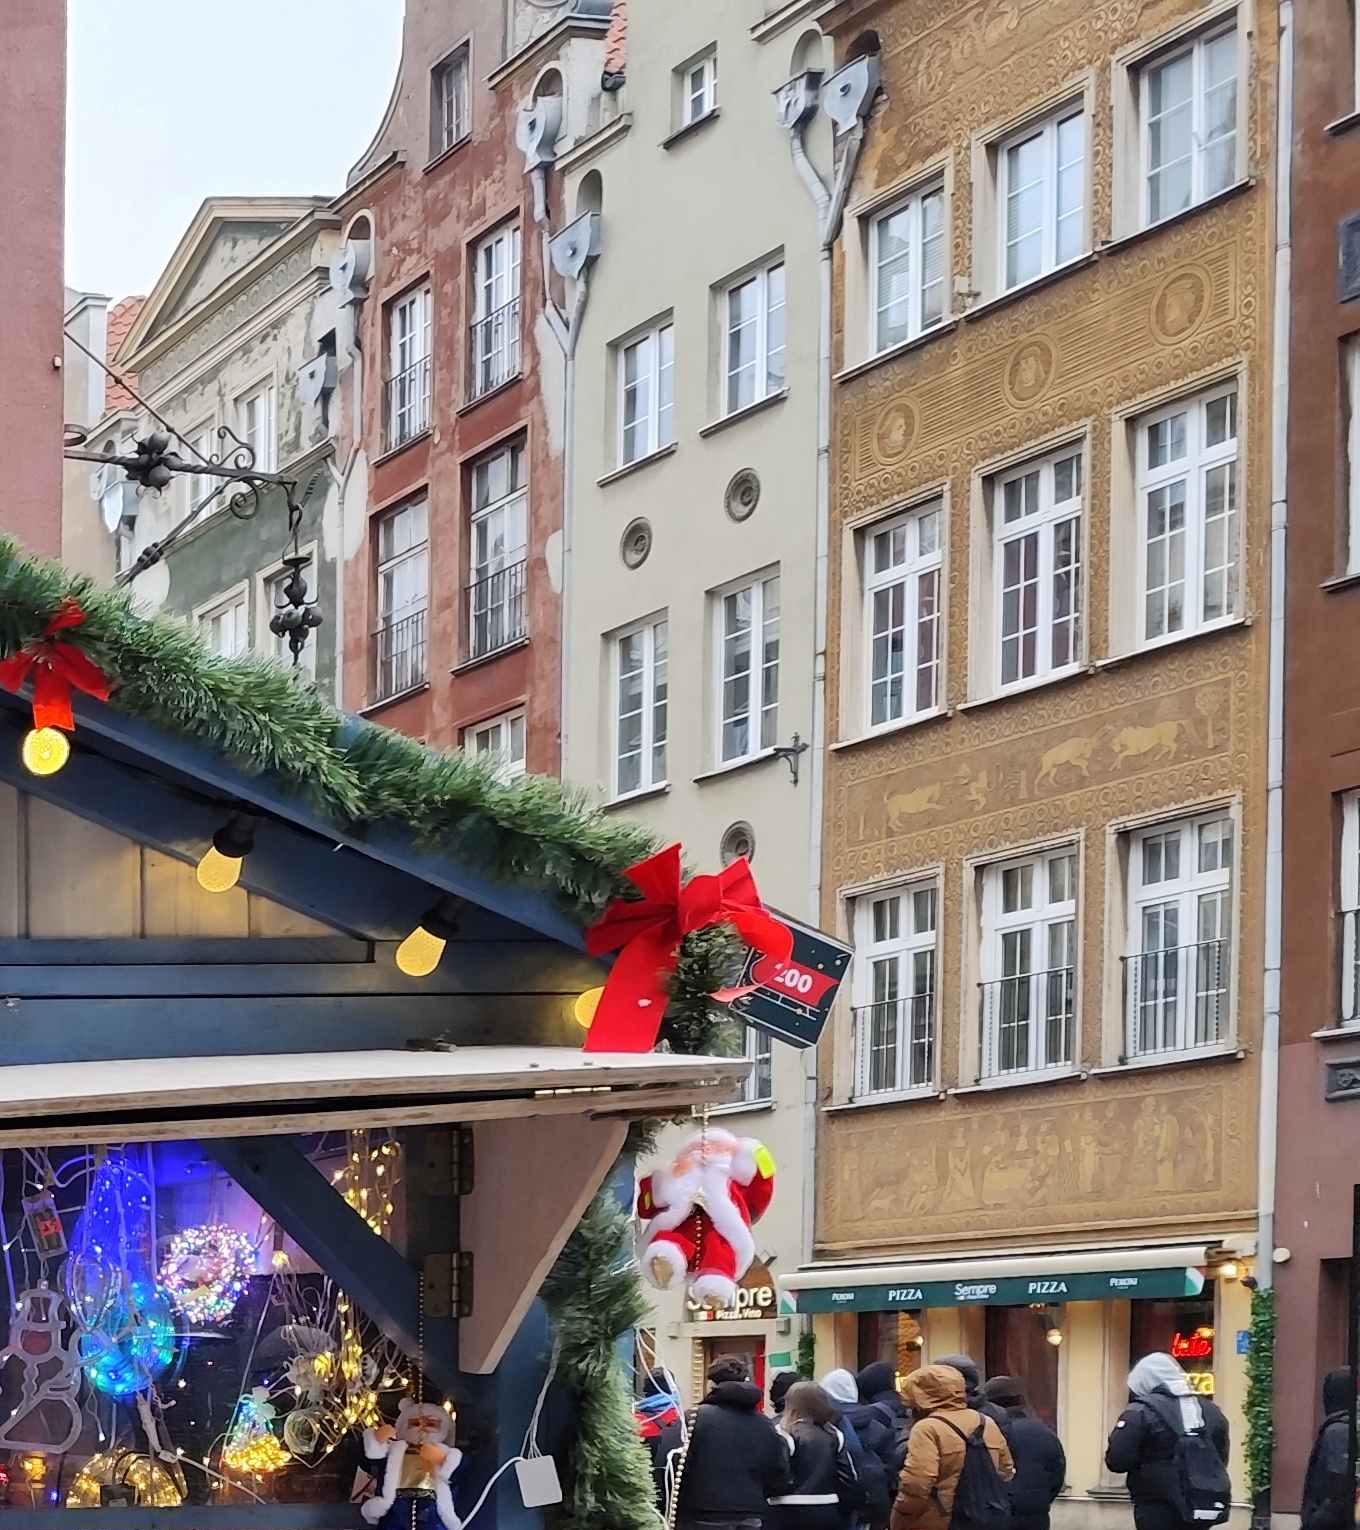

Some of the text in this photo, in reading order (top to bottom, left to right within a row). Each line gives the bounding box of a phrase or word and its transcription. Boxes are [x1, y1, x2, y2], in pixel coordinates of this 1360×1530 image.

[887, 1288, 923, 1302] PIZZA
[953, 1283, 998, 1298] Sempre
[1027, 1281, 1068, 1294] PIZZA
